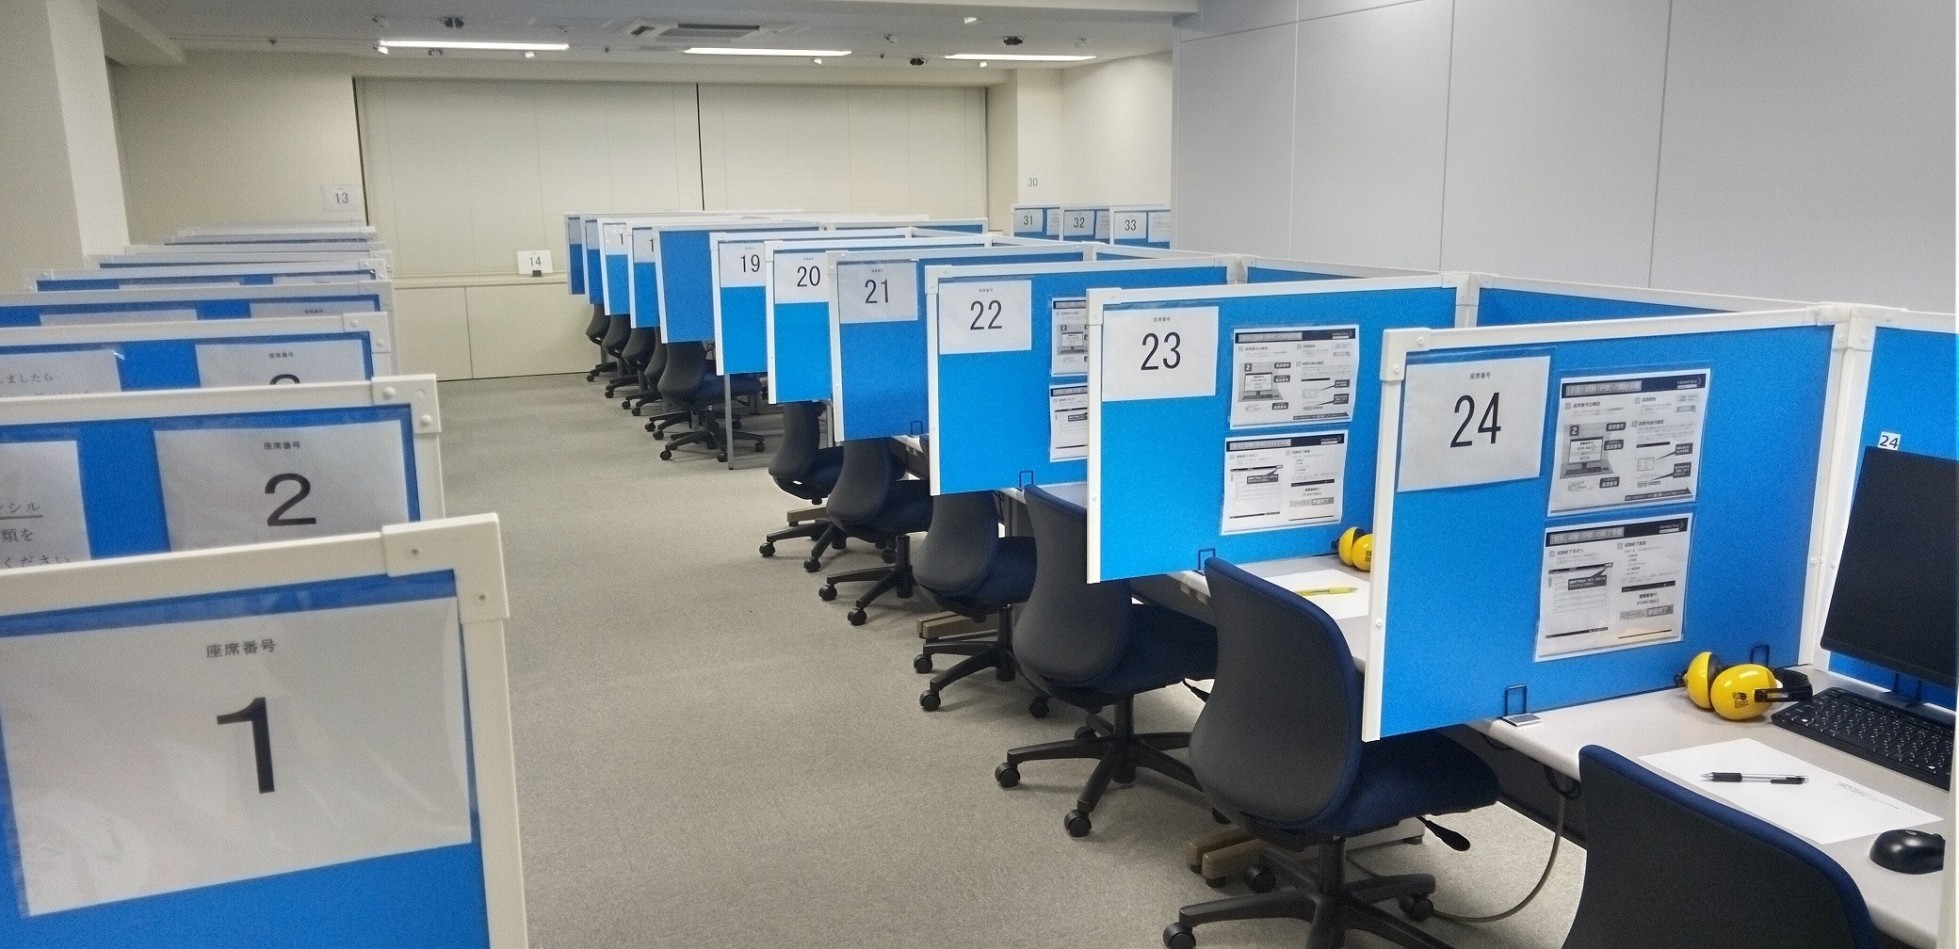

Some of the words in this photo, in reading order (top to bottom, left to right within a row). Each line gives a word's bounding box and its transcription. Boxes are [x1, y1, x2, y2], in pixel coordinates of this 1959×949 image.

[1027, 177, 1039, 188] 30
[335, 192, 349, 204] 13
[1023, 215, 1033, 226] 31
[1073, 217, 1085, 229] 32
[1124, 219, 1137, 231] 33
[529, 256, 542, 267] 14
[740, 254, 761, 273] 19
[796, 265, 821, 287] 20
[864, 278, 889, 304] 21
[970, 299, 1003, 331] 22
[1140, 331, 1182, 371] 23
[0, 373, 53, 384] ましたら
[1449, 392, 1502, 448] 24
[1571, 426, 1578, 435] 2
[1879, 434, 1899, 449] 24
[264, 472, 317, 527] 2
[206, 638, 276, 658] 座席番号
[216, 696, 275, 794] 1
